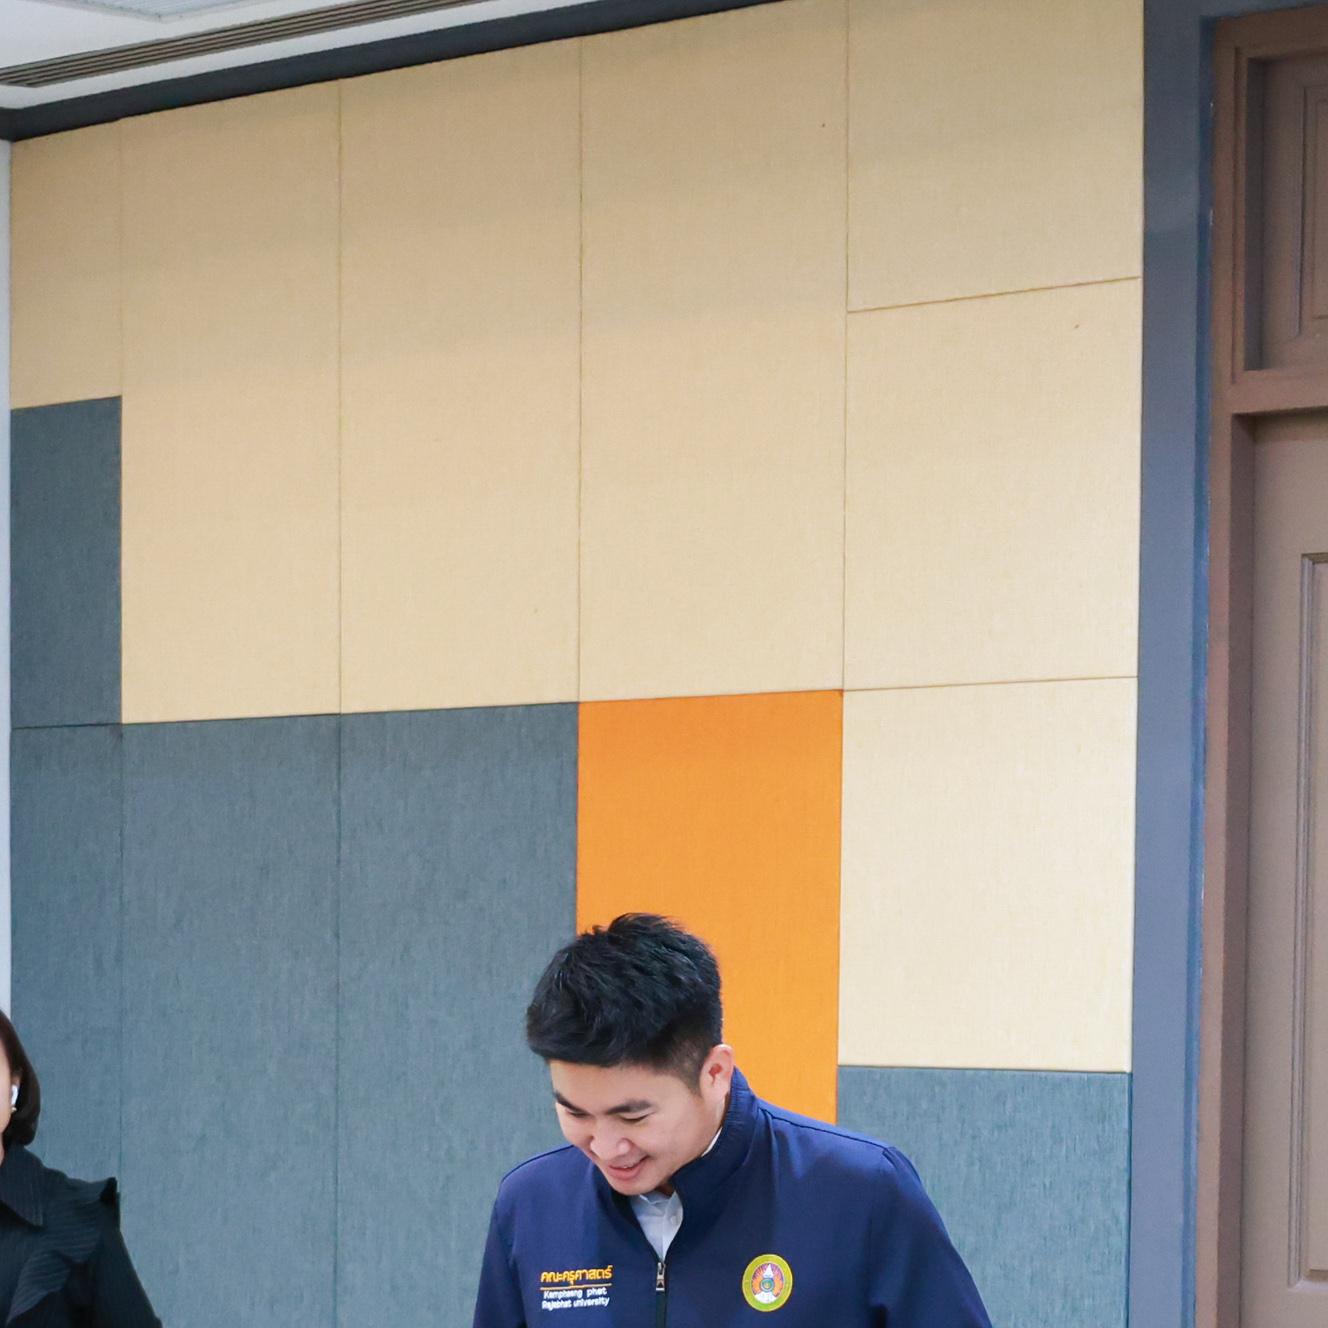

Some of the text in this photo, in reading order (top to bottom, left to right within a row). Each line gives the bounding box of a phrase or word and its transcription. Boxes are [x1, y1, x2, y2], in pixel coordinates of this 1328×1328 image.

[540, 1264, 613, 1285] คณะครุศาสตร์
